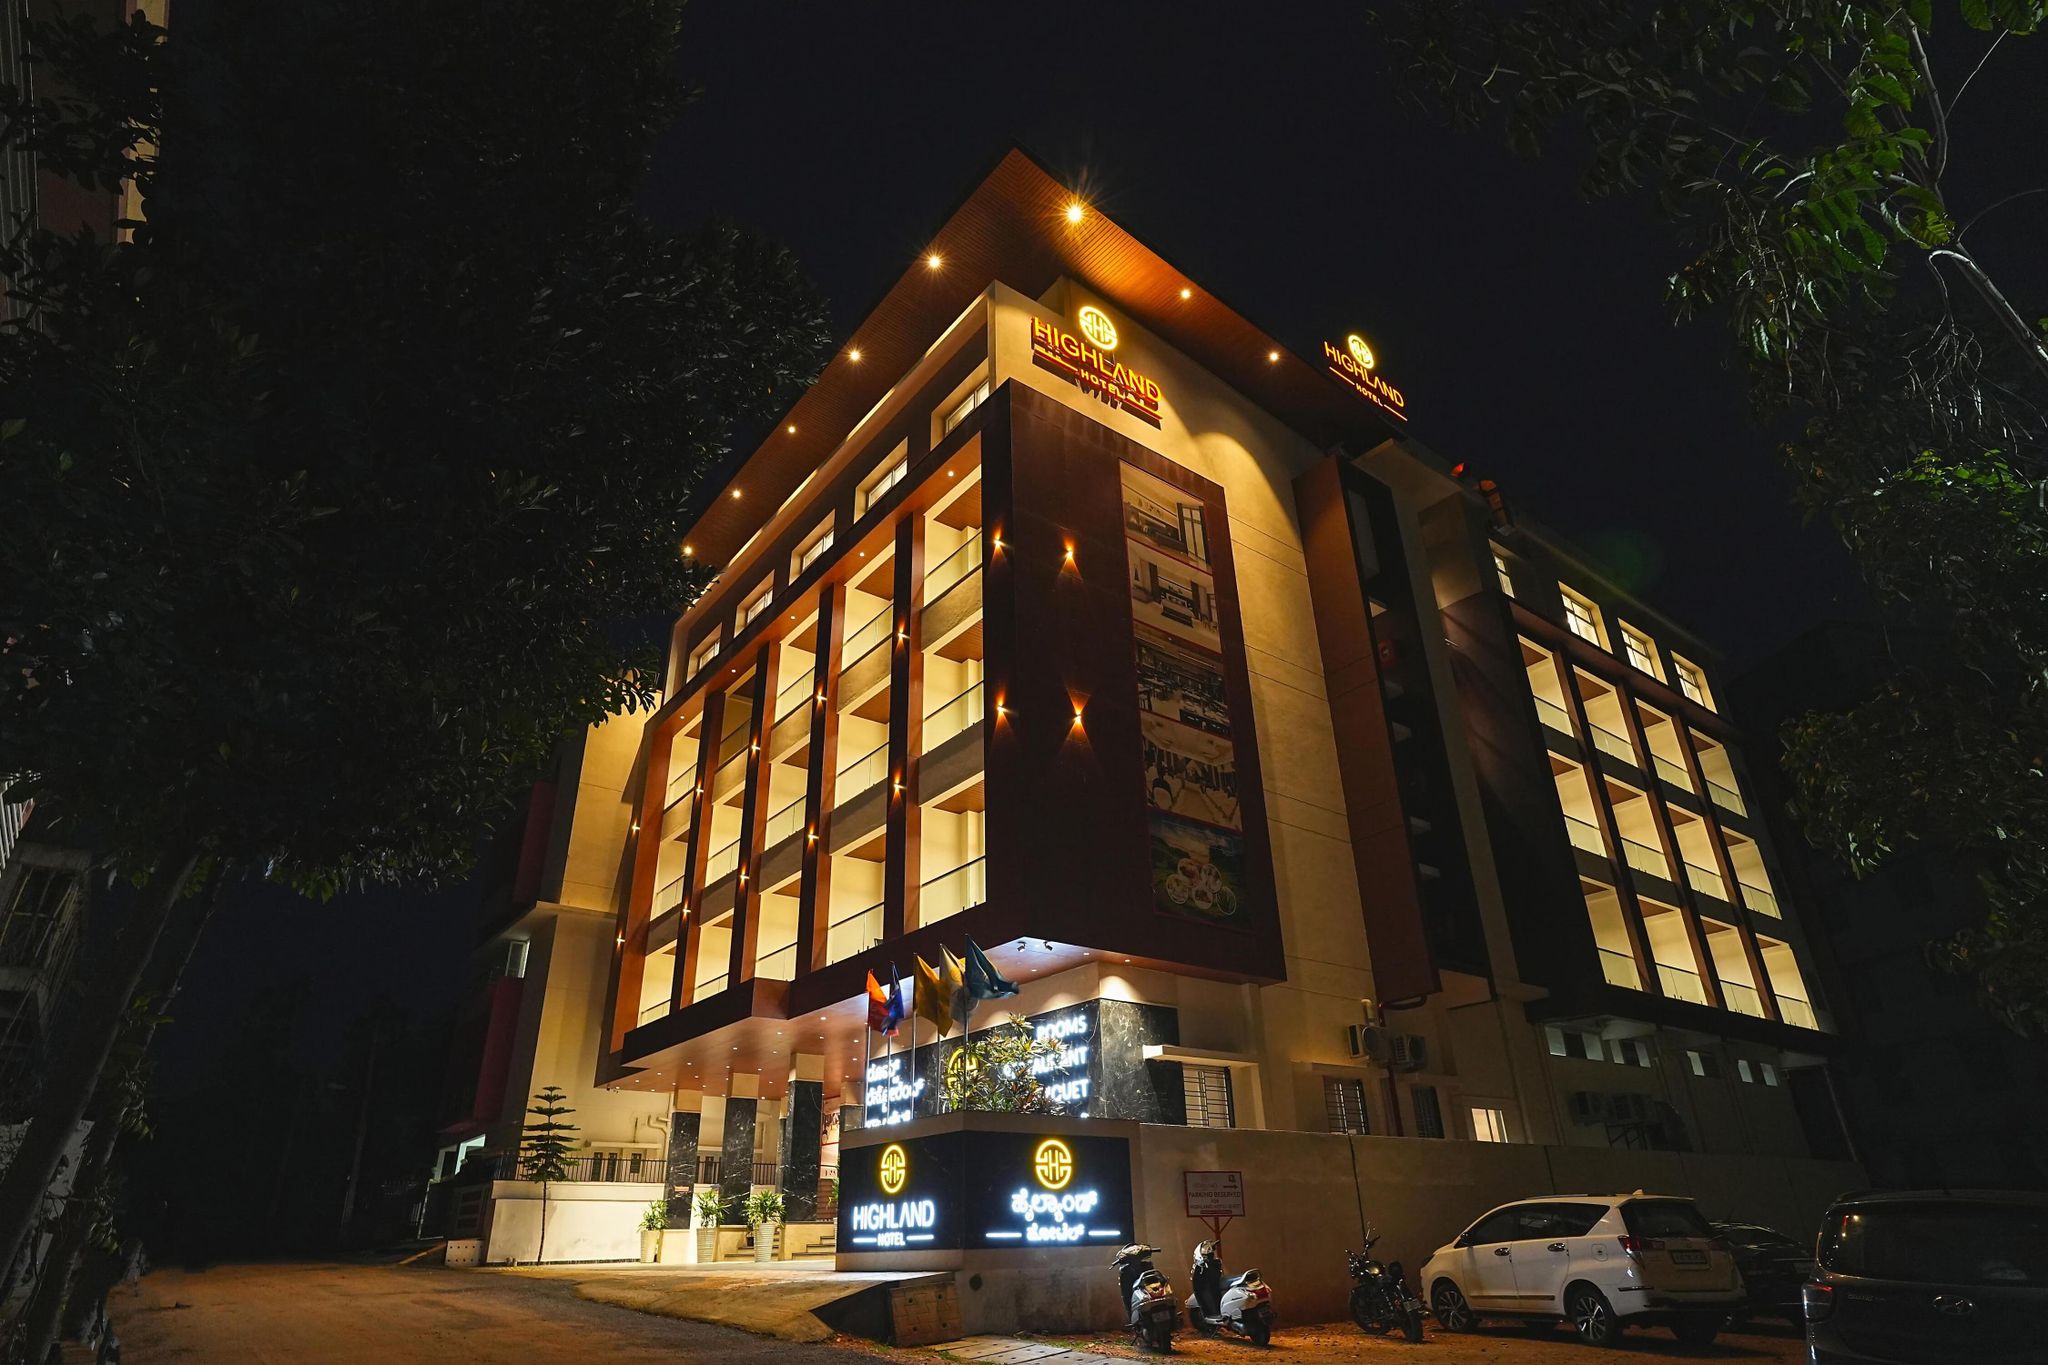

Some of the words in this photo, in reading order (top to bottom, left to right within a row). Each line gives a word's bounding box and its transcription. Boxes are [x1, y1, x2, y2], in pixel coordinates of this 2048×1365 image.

[1033, 316, 1163, 404] HIGHLAND
[1324, 341, 1405, 408] HIGHLAND
[1081, 369, 1126, 400] HOTEL
[1354, 383, 1384, 407] HOTEL
[1036, 1015, 1087, 1040] ROOMS
[853, 1200, 936, 1231] HIGHLAND
[877, 1232, 906, 1247] HOTEL
